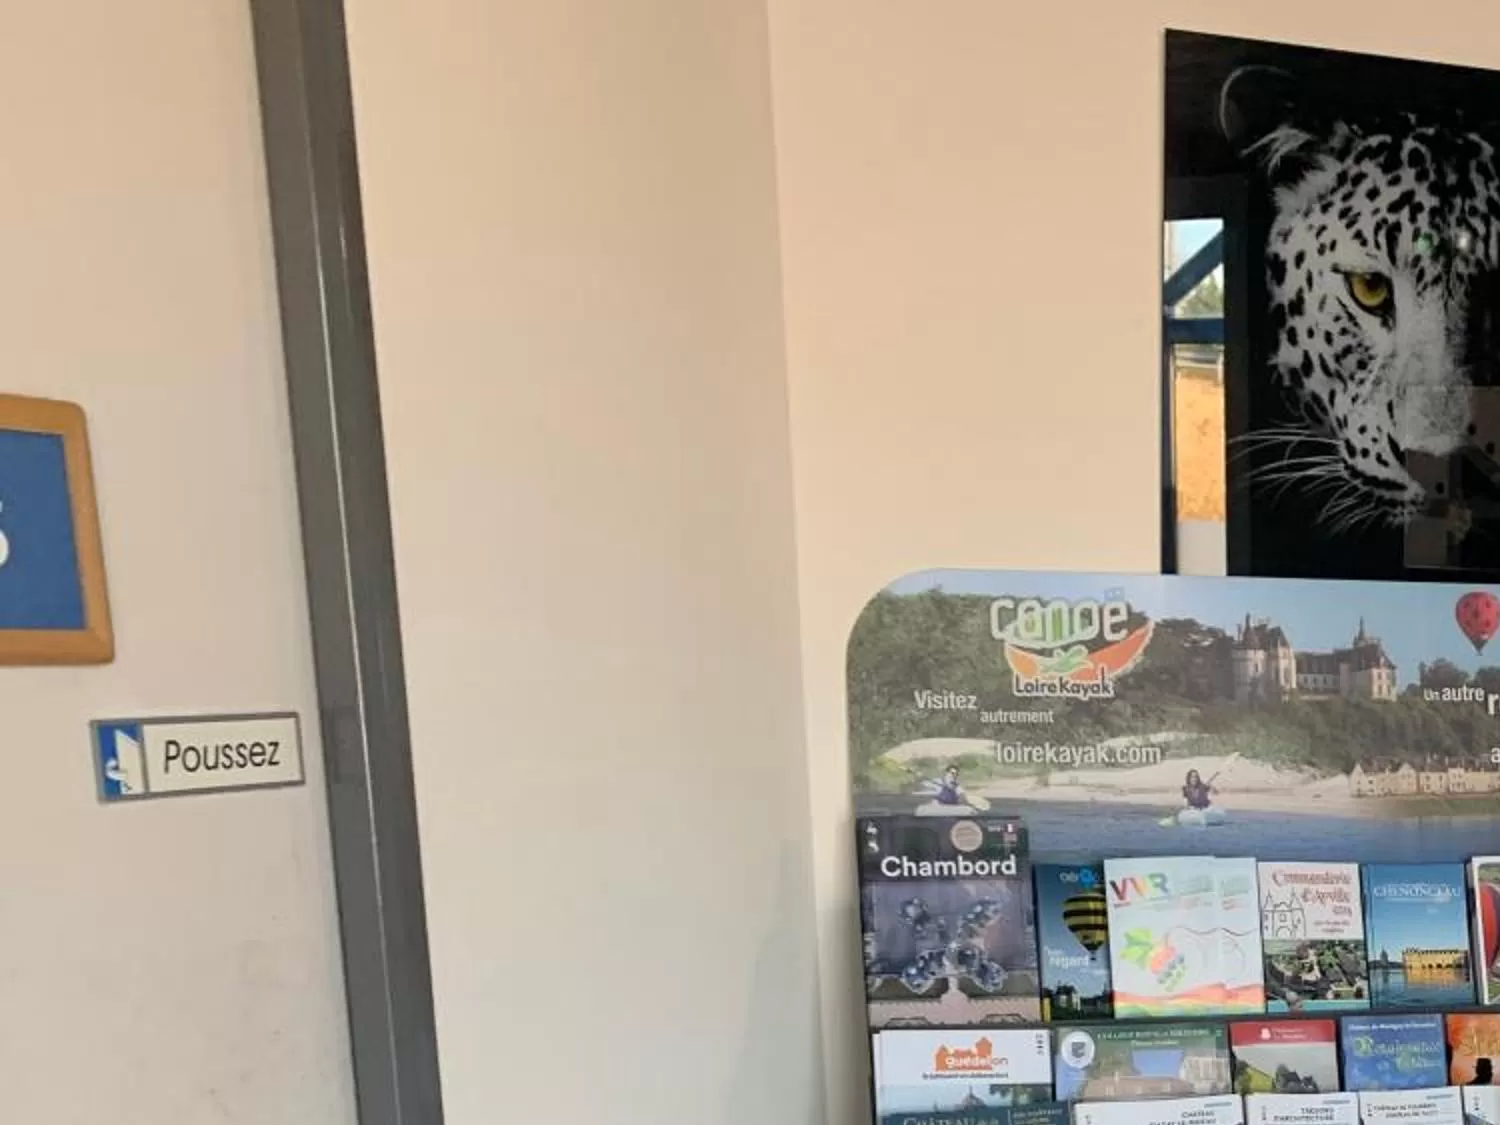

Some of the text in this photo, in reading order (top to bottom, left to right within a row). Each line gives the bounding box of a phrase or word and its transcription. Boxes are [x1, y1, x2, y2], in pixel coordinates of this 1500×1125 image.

[913, 690, 978, 711] Visitez
[1441, 685, 1485, 702] autre
[980, 709, 1054, 724] autrement
[164, 738, 280, 774] Poussez
[996, 741, 1161, 768] loirekayak.com
[881, 854, 1017, 877] Chambord
